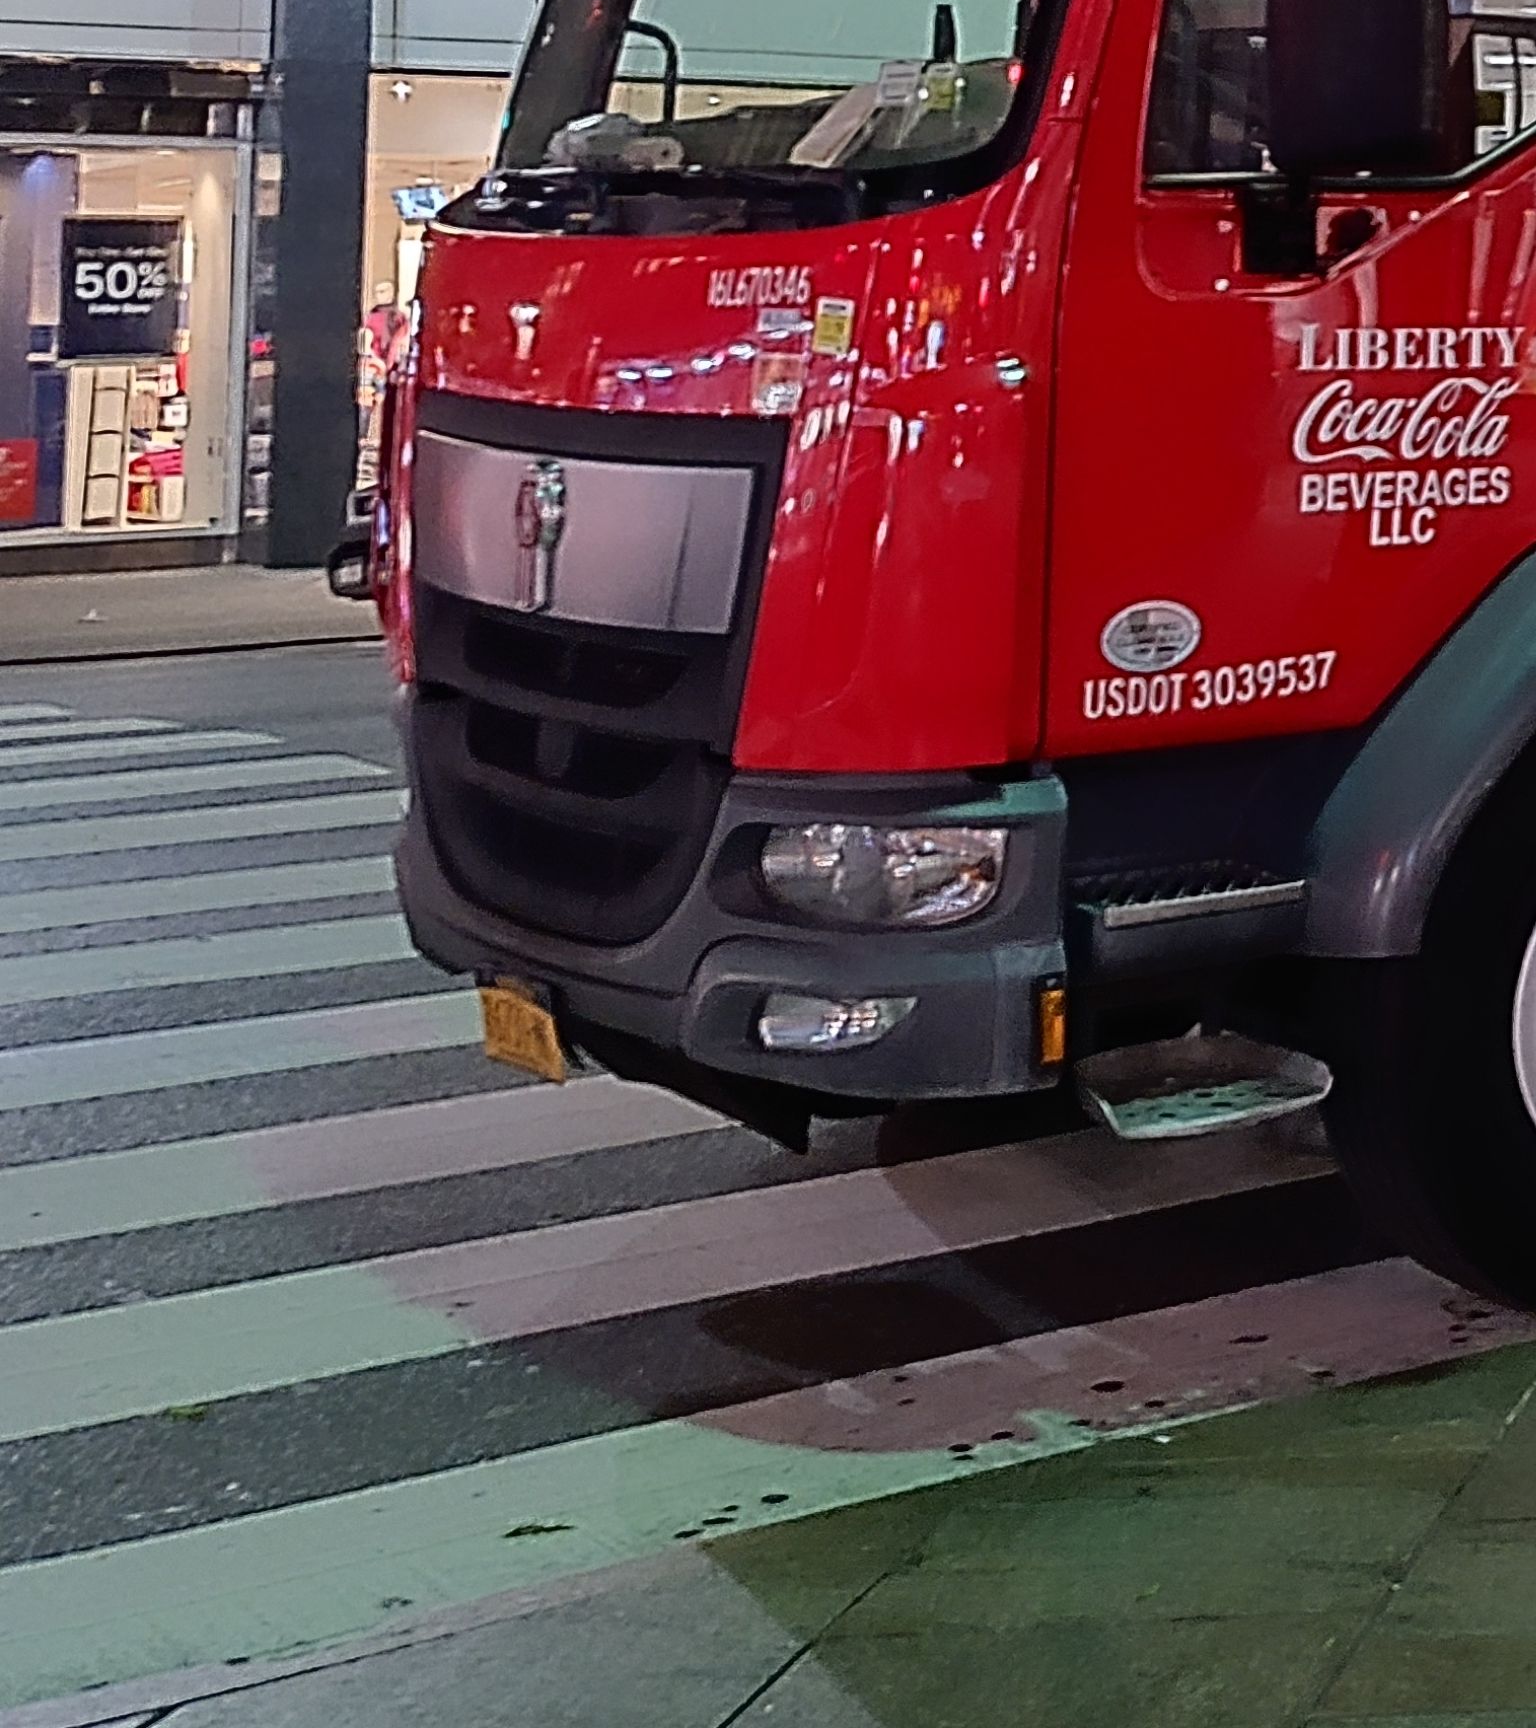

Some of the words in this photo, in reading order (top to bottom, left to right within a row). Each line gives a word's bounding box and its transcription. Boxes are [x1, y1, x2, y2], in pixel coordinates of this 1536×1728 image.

[75, 261, 168, 300] 50%
[1296, 322, 1526, 370] LIBERTY
[1292, 376, 1522, 463] Coca-Cola
[1299, 466, 1512, 512] BEVERAGES
[1369, 506, 1438, 546] LLC
[1083, 673, 1188, 720] USDOT
[1190, 650, 1338, 710] 3039537
